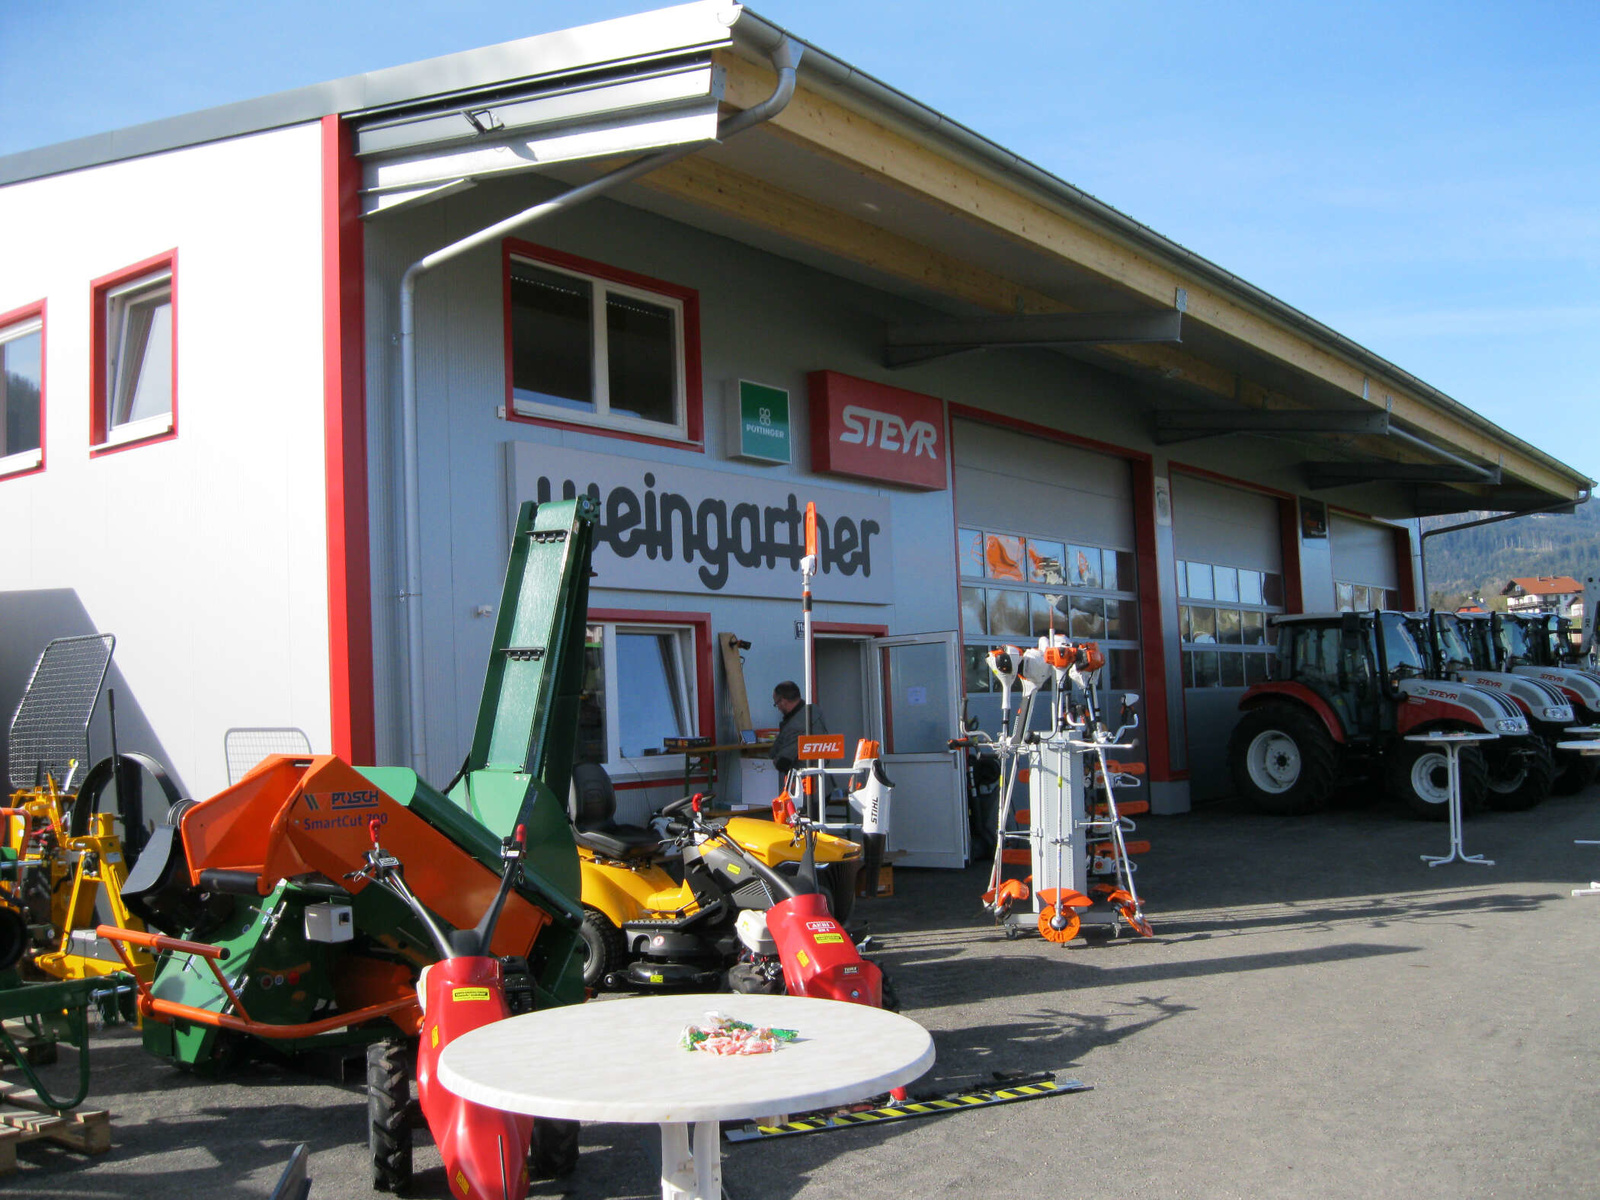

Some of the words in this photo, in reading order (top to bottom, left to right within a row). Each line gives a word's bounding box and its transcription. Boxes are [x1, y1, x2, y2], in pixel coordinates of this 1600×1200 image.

[840, 405, 937, 459] STEYR
[1476, 678, 1502, 688] STEYR
[1428, 689, 1458, 700] STEYR
[802, 742, 839, 753] STIHL
[871, 797, 879, 825] STIHL
[304, 814, 362, 831] SmartCut
